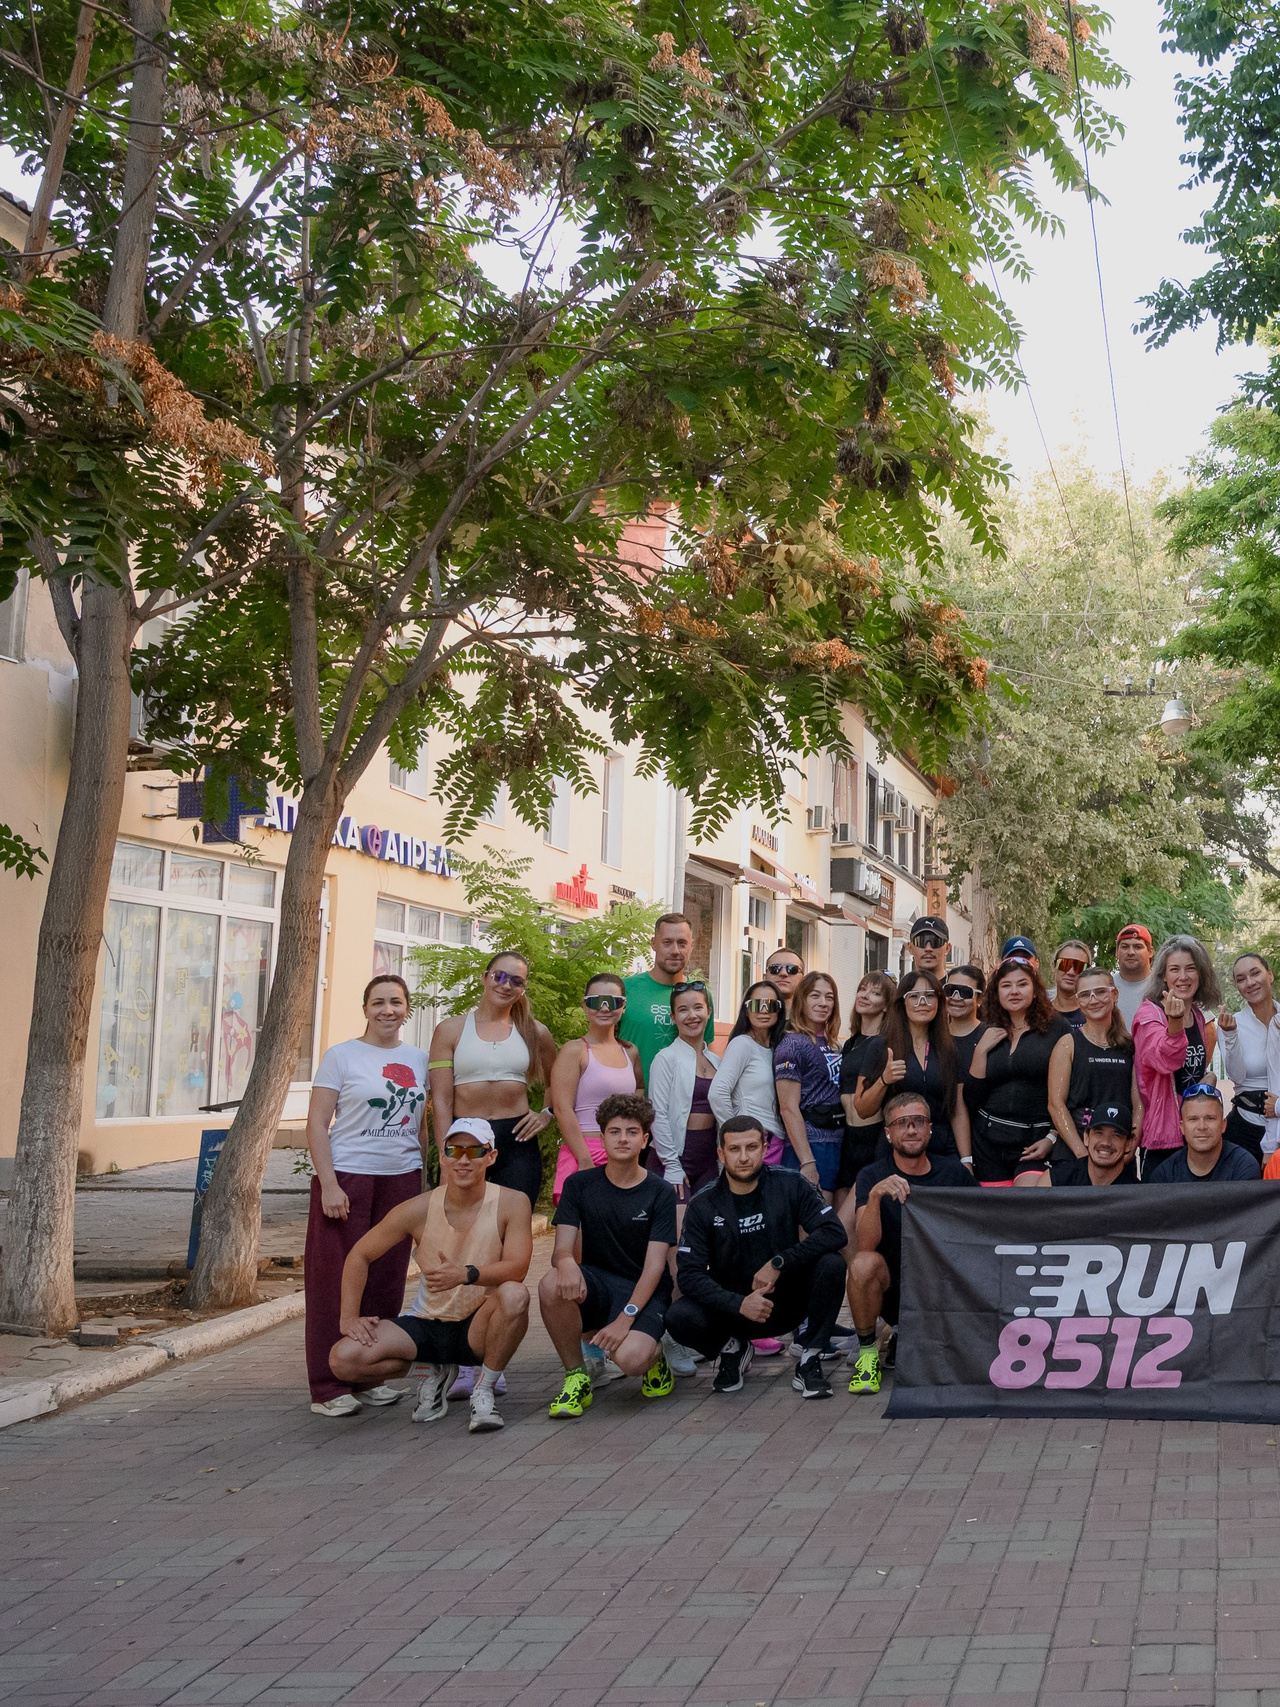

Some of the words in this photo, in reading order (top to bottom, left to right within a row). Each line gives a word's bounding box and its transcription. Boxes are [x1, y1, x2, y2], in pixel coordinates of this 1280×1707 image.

[263, 783, 361, 850] АПКА
[654, 1014, 674, 1026] RU
[1030, 1241, 1247, 1317] RUN
[988, 1317, 1194, 1389] 8512
